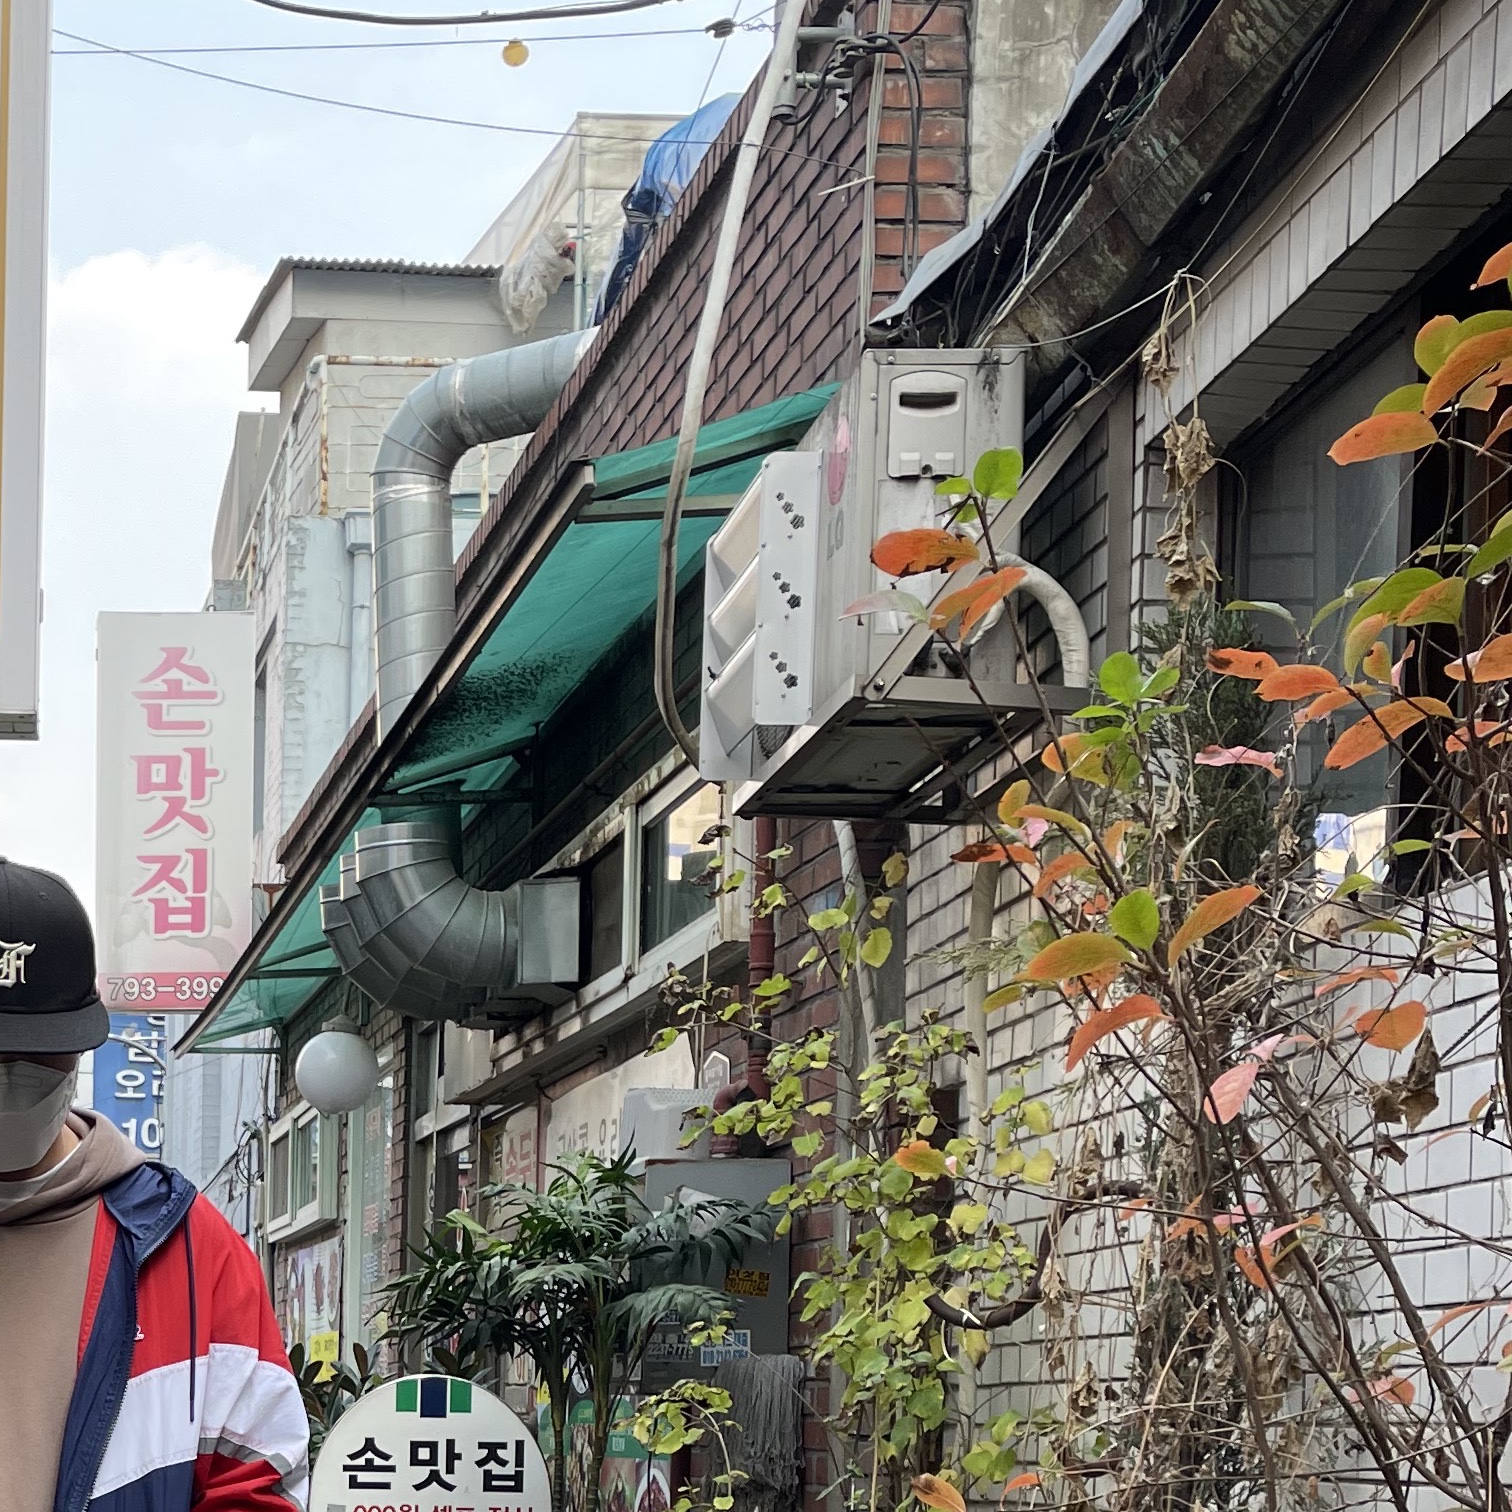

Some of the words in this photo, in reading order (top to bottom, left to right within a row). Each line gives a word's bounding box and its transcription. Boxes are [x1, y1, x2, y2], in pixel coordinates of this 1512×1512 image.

[130, 646, 221, 936] 손맛집
[107, 976, 225, 1001] 793-399
[342, 1436, 526, 1493] 손맛집
